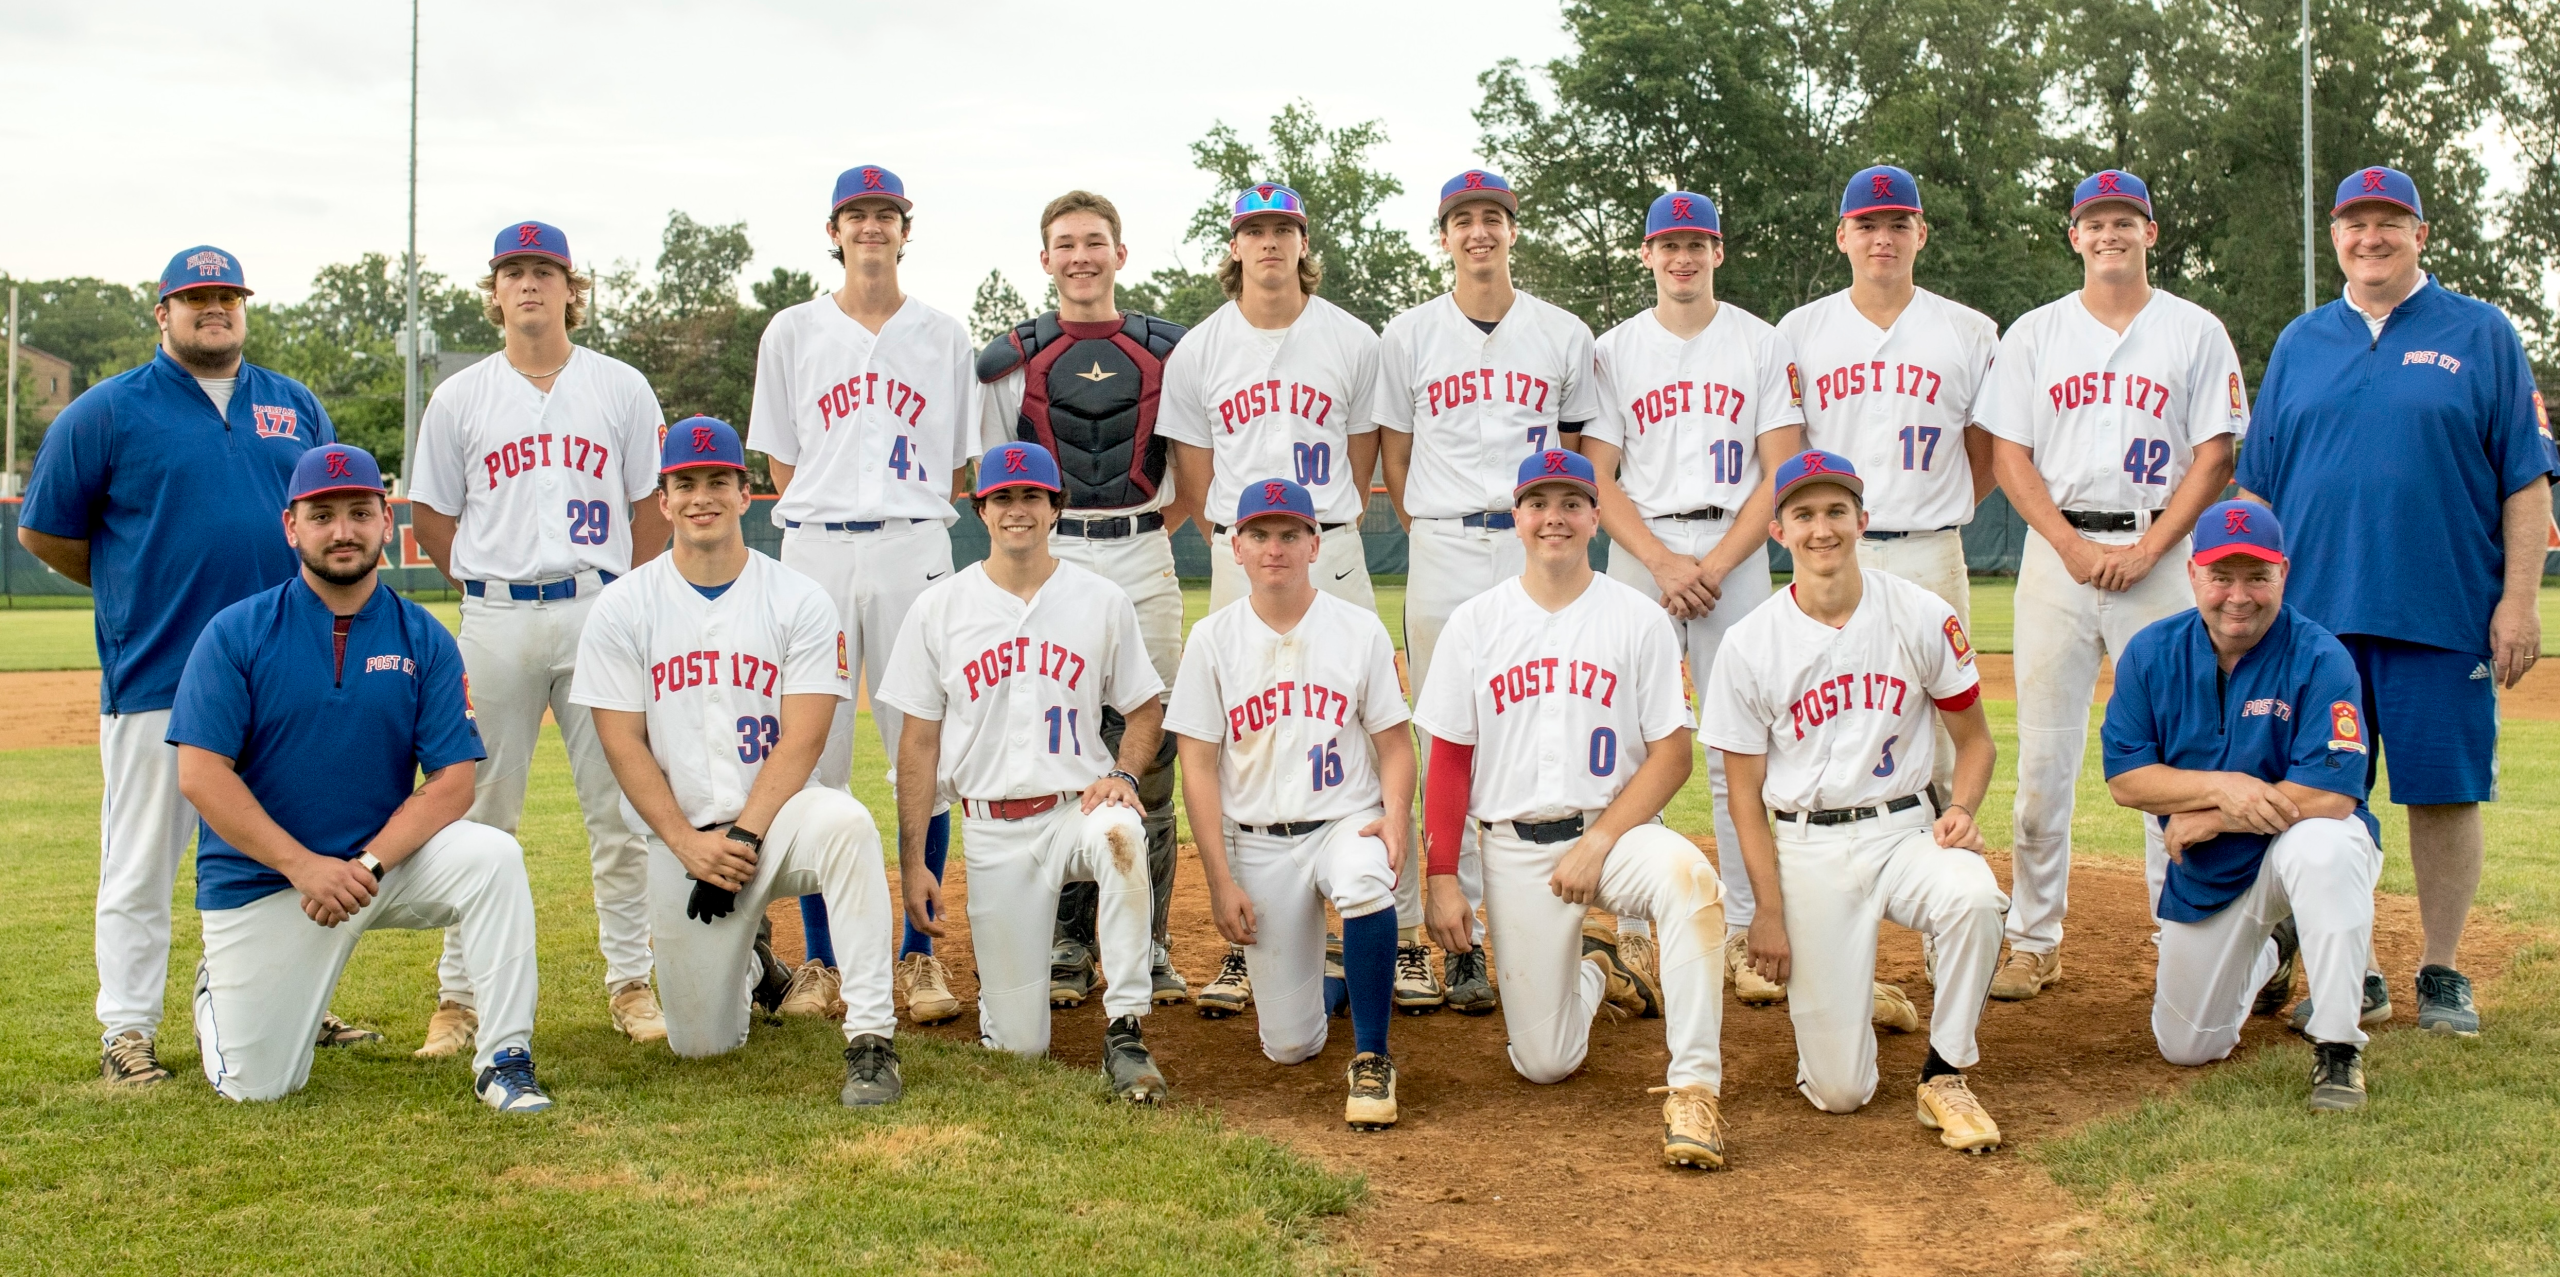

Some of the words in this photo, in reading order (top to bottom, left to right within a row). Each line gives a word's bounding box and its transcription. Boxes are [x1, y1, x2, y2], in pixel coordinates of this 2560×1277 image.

[200, 265, 220, 276] 177
[1817, 362, 1884, 410] POST
[1897, 364, 1940, 404] 177
[2402, 351, 2439, 366] POST
[2438, 353, 2461, 374] 177
[818, 372, 877, 432] POST
[888, 380, 925, 426] 177
[1219, 381, 1280, 434] POST
[1291, 383, 1331, 426] 177
[1428, 369, 1493, 416] POST
[1506, 372, 1548, 412] 177
[1632, 382, 1692, 434] POST
[1704, 383, 1744, 423] 177
[2049, 372, 2115, 417] POST
[2126, 376, 2168, 418] 177
[254, 412, 297, 436] 177
[1527, 426, 1548, 453] 7
[485, 434, 551, 489] POST
[564, 436, 607, 479] 177
[1293, 442, 1331, 486] 00
[1710, 440, 1743, 484] 10
[1899, 426, 1941, 471] 17
[2123, 438, 2170, 485] 42
[566, 500, 610, 545] 29
[366, 655, 401, 673] POST
[402, 657, 417, 679] 17
[652, 651, 719, 701] POST
[732, 653, 777, 697] 177
[964, 638, 1029, 701] POST
[1040, 642, 1084, 690] 177
[1490, 658, 1558, 714] POST
[1570, 662, 1616, 707] 177
[1230, 682, 1294, 742] POST
[1303, 684, 1347, 726] 177
[1790, 674, 1853, 740] POST
[1864, 673, 1906, 715] 177
[737, 715, 780, 764] 33
[1590, 726, 1616, 777] 0
[1308, 738, 1343, 791] 15
